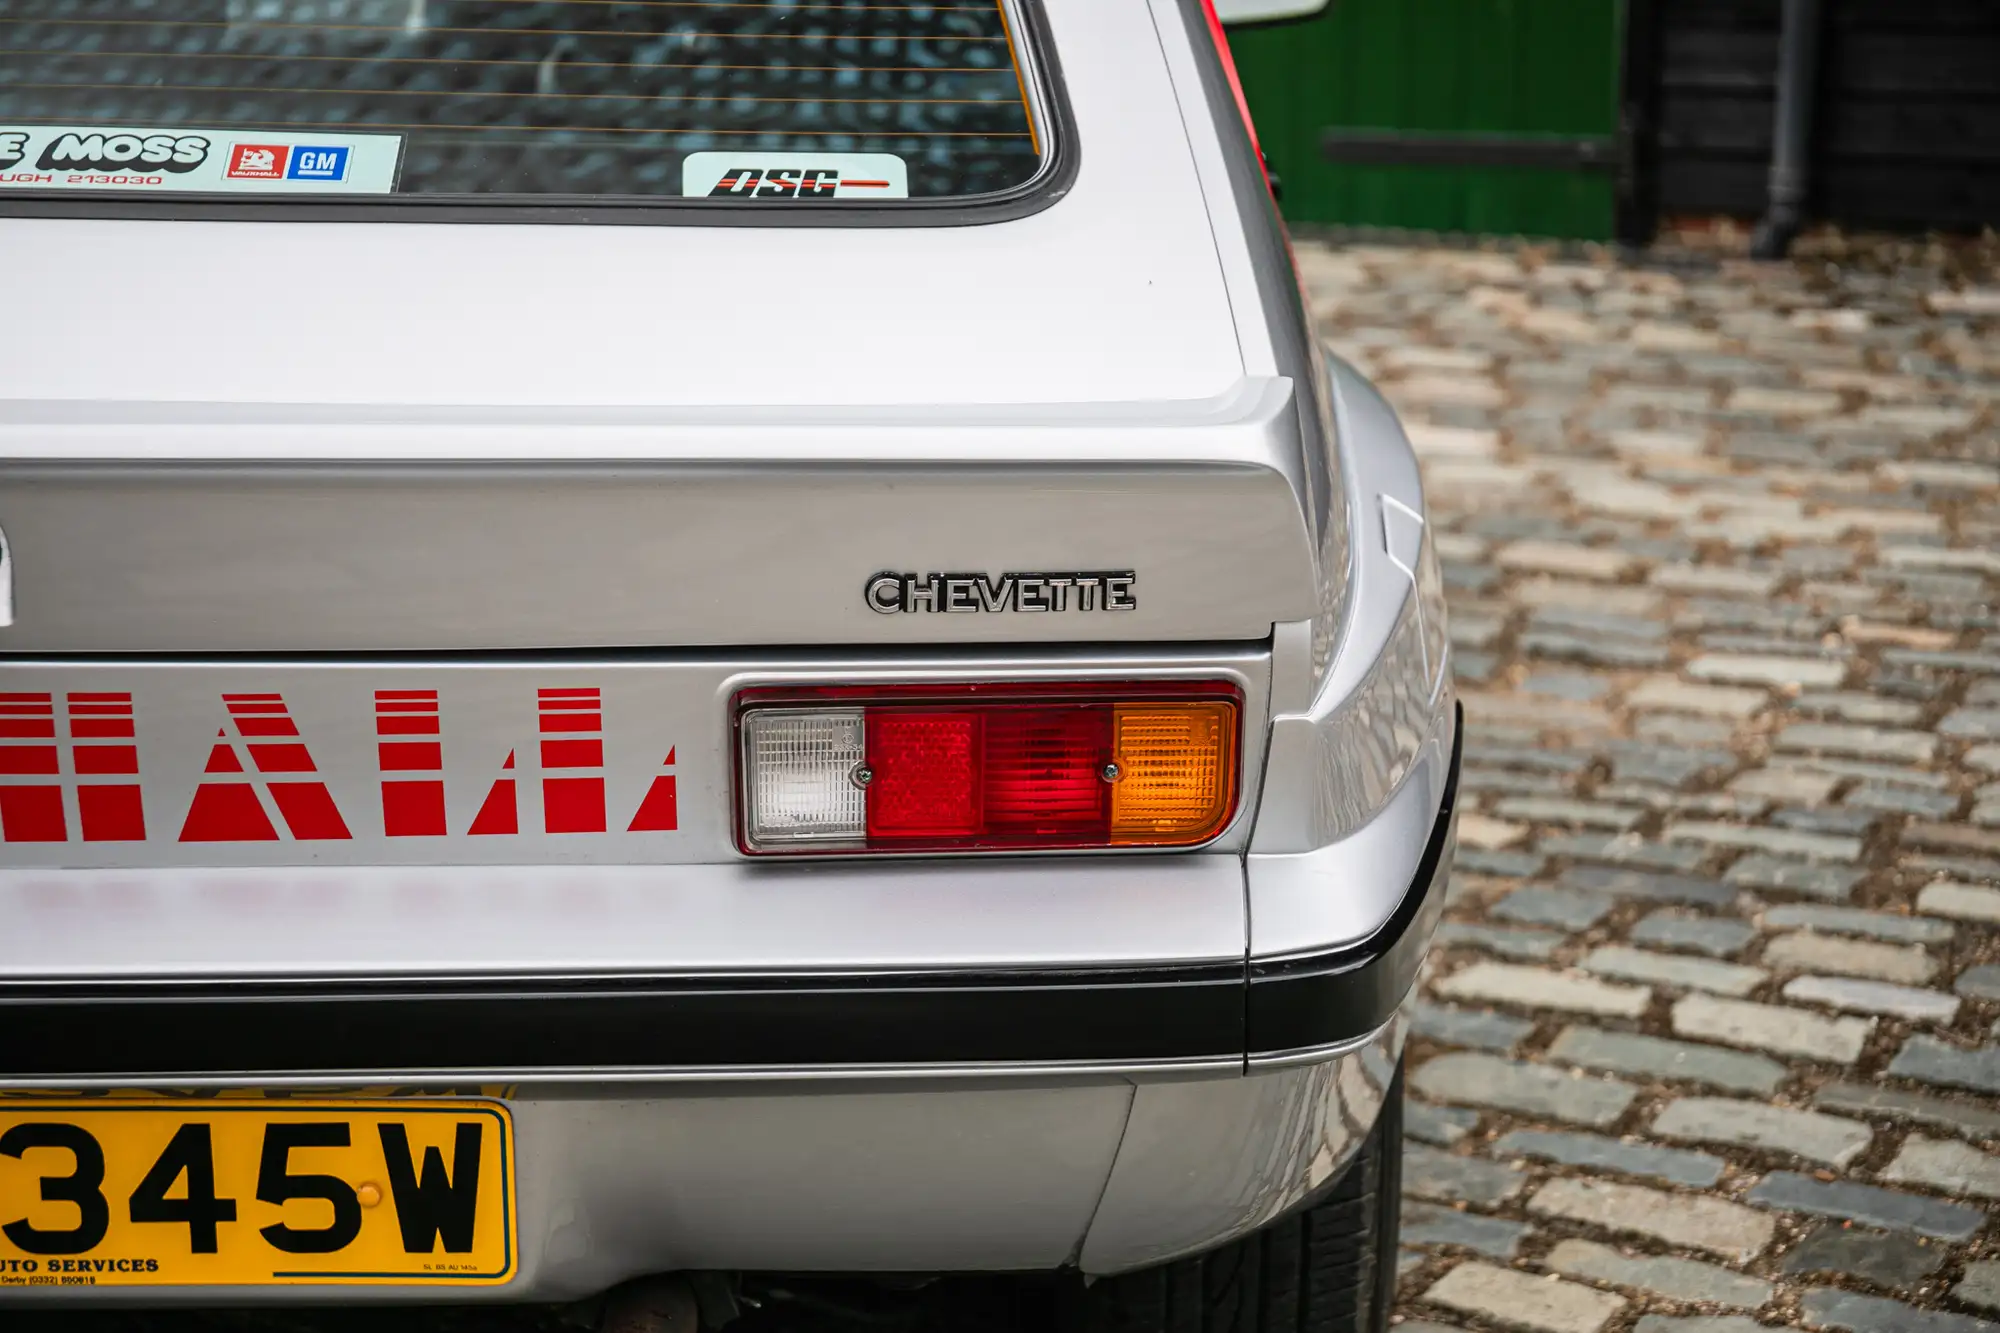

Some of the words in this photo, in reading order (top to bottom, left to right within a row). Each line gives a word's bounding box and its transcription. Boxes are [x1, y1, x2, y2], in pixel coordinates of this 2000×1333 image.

[35, 132, 211, 173] MOSS
[299, 151, 338, 170] GM
[67, 174, 163, 185] 213030
[864, 570, 1137, 614] CHEVETTE
[0, 1122, 483, 1254] 345W
[47, 1258, 159, 1273] SERVICES
[1, 1275, 27, 1285] Derby
